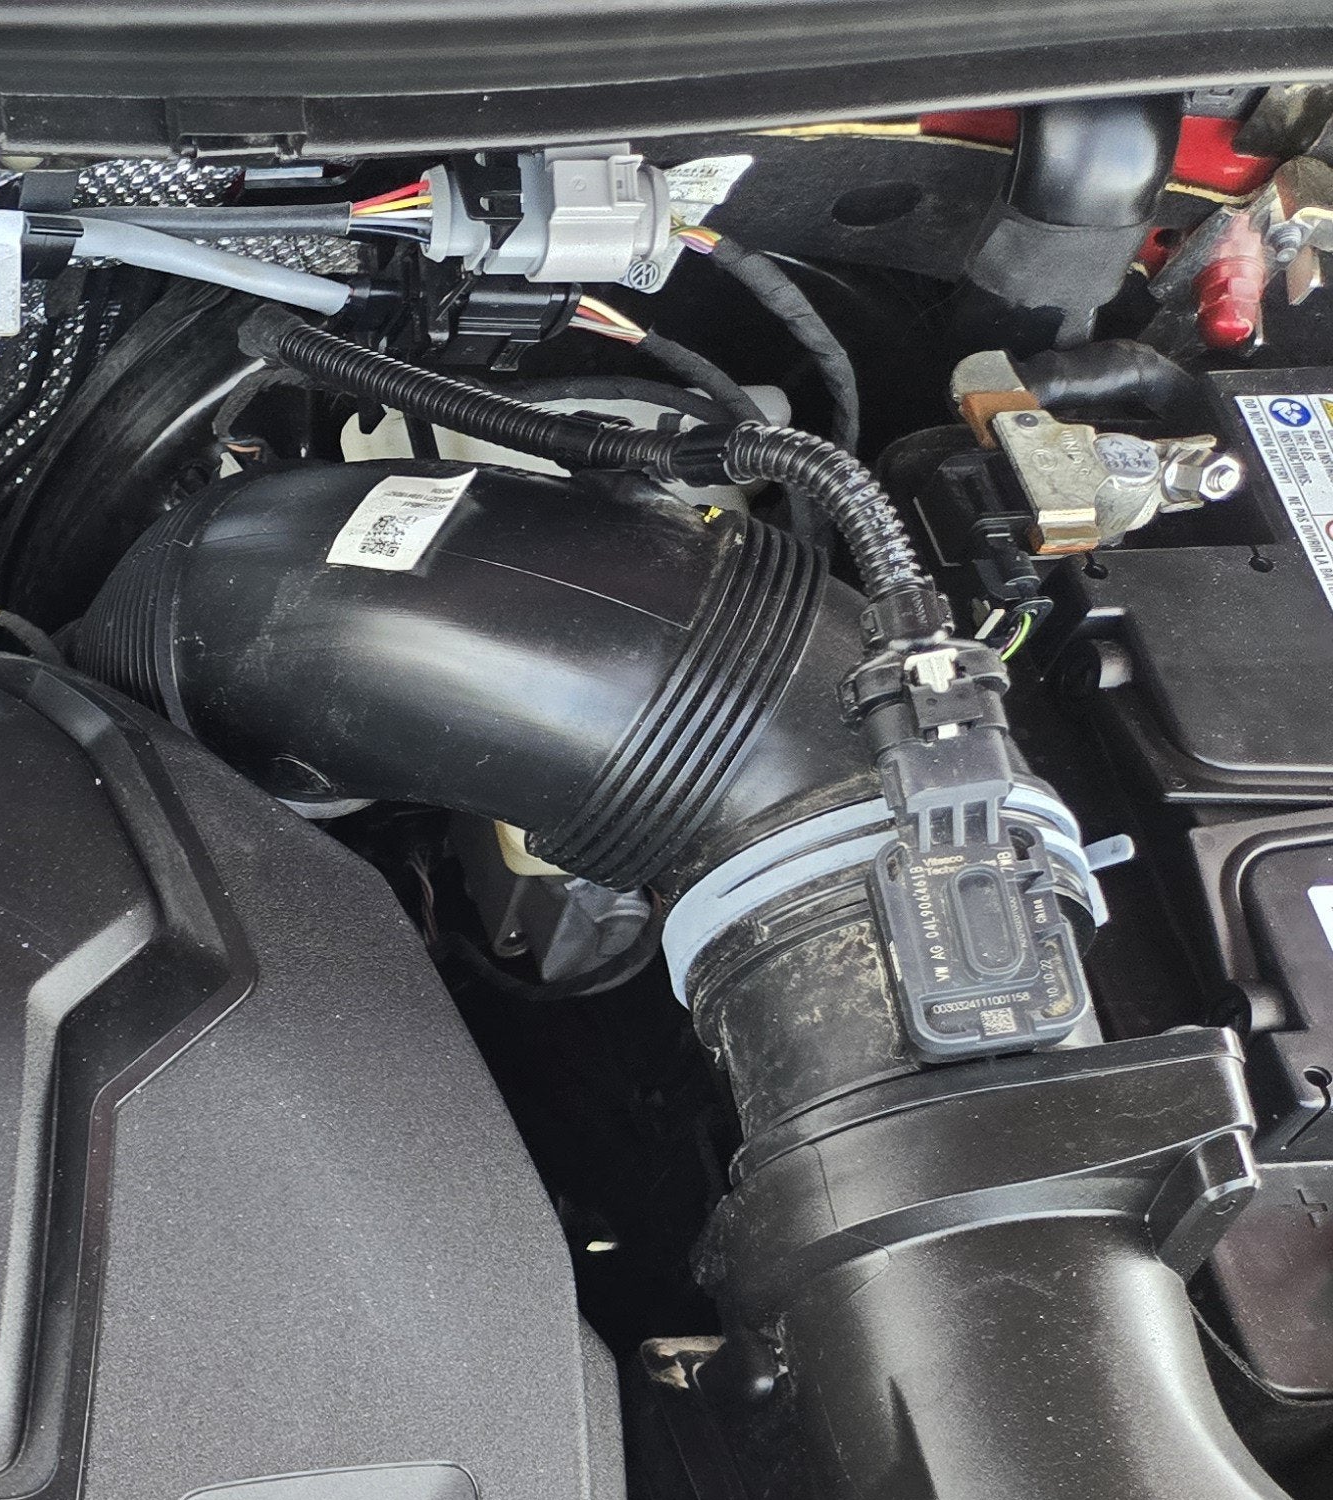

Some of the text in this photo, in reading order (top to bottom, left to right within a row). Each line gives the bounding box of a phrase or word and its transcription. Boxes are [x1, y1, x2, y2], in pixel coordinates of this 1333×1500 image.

[1249, 411, 1265, 426] NOT
[1287, 496, 1302, 506] NE
[1292, 509, 1309, 522] PAS
[1313, 554, 1330, 566] LA
[930, 945, 946, 960] AG
[934, 966, 950, 983] VW
